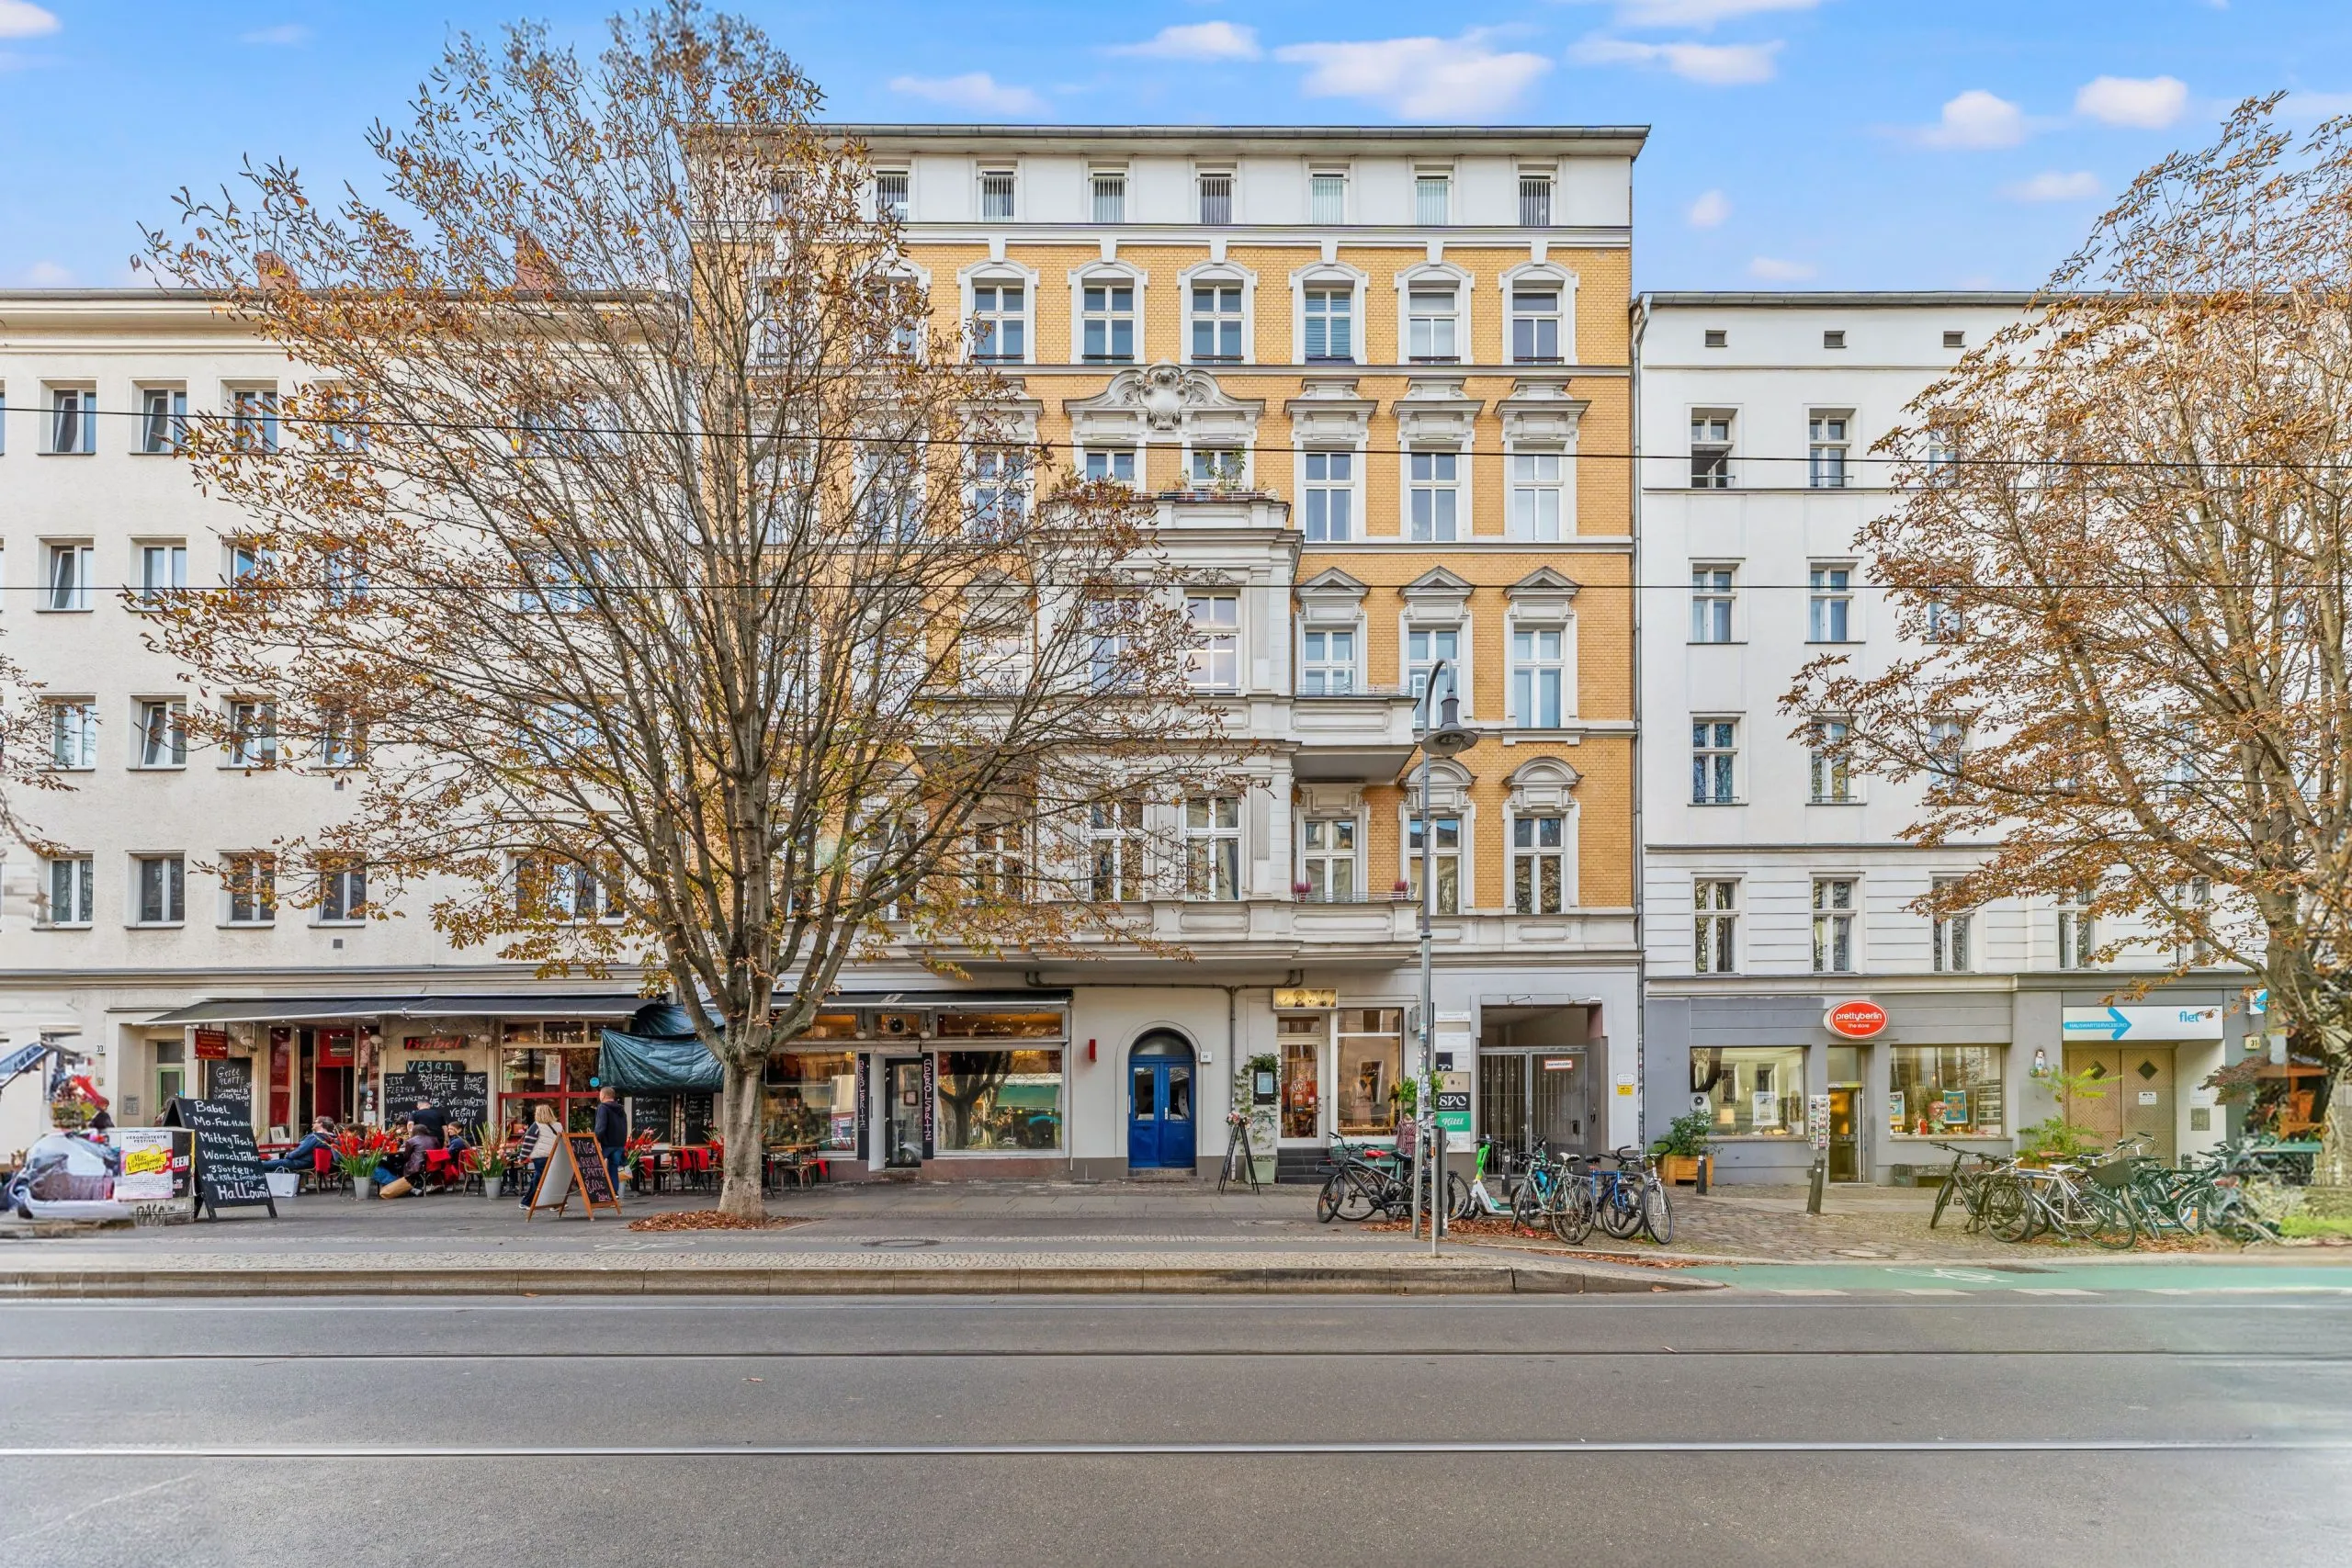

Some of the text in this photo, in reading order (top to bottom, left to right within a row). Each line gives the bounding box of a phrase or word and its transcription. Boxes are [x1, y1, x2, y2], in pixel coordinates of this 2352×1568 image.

[1836, 1011, 1883, 1021] prettyberlin
[2250, 1039, 2257, 1047] 31
[96, 1044, 104, 1053] 33
[194, 1100, 231, 1114] Babel
